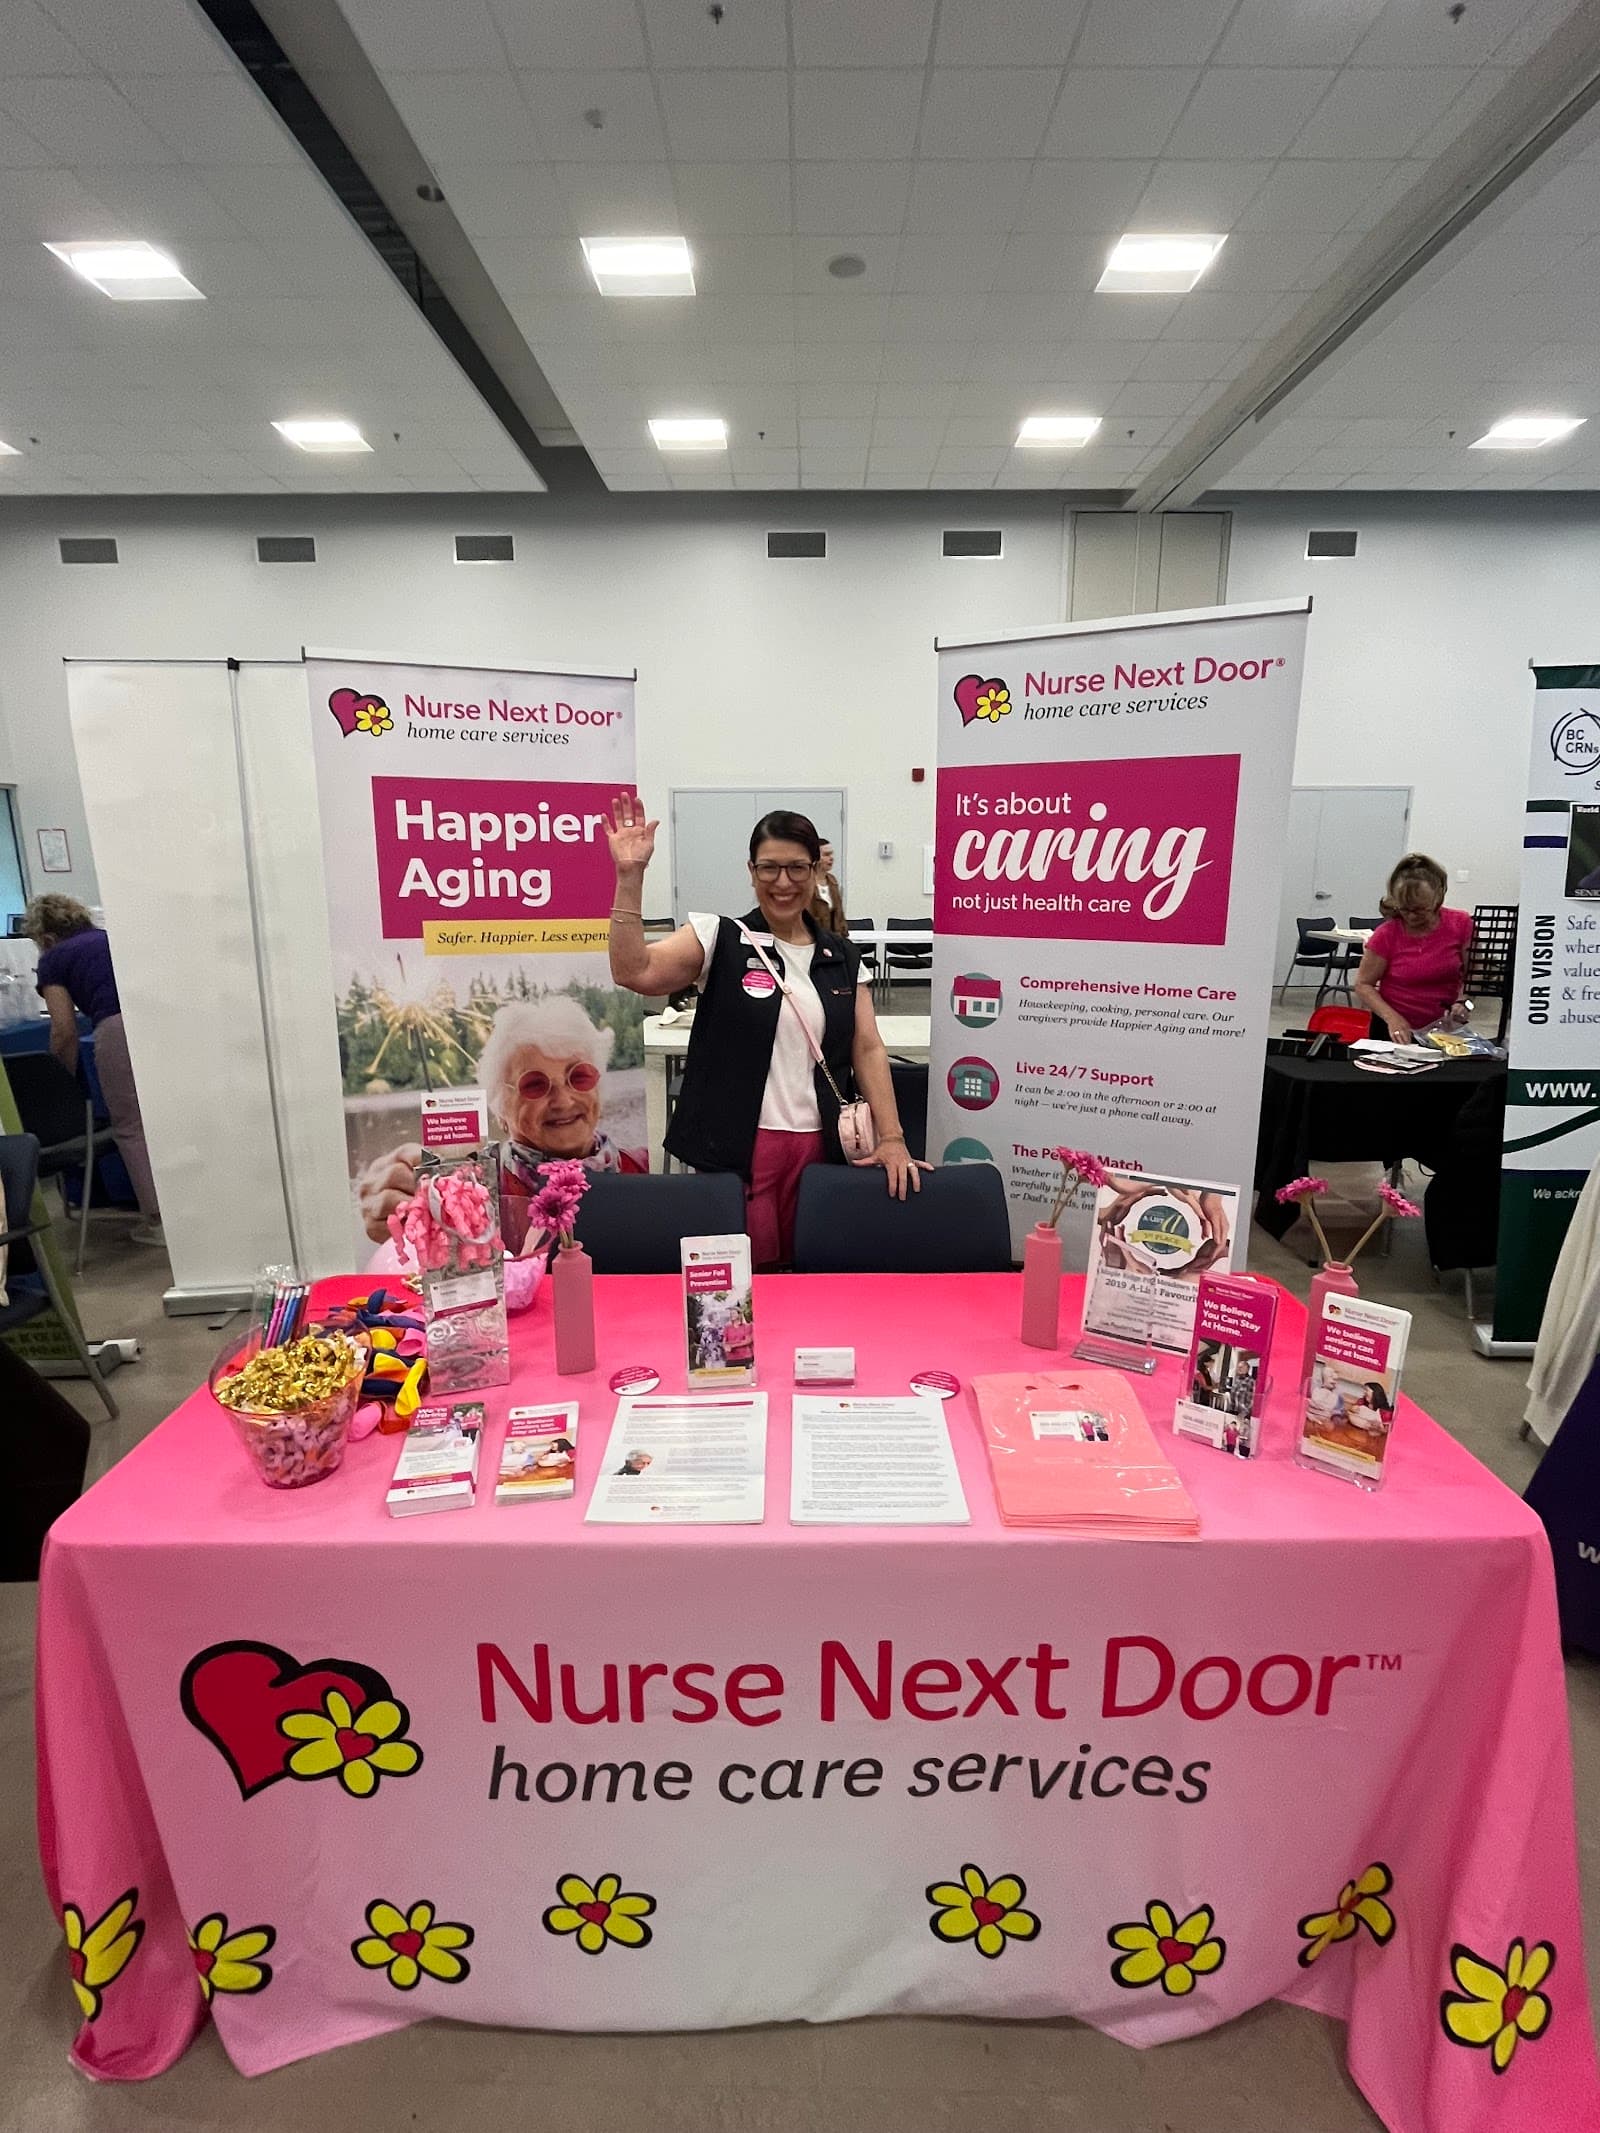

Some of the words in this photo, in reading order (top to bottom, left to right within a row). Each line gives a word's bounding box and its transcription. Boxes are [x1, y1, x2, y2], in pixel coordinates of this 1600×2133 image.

[1025, 671, 1105, 697] Nurse
[1114, 662, 1184, 690] Next
[404, 694, 480, 721] Nurse
[488, 699, 548, 724] Next
[1024, 699, 1074, 721] home
[1079, 700, 1121, 717] care
[1126, 693, 1208, 713] services
[407, 722, 455, 740] home
[460, 728, 497, 742] care
[502, 729, 570, 745] services
[1566, 729, 1585, 740] BC
[955, 793, 988, 816] It's
[994, 792, 1071, 815] about
[395, 799, 601, 851] Happier
[952, 802, 1214, 921] caring
[398, 857, 551, 907] Aging
[952, 895, 980, 910] not
[983, 893, 1018, 913] just
[1022, 894, 1083, 912] health
[1088, 899, 1131, 913] care
[1566, 915, 1597, 930] Safe
[437, 931, 477, 947] Safer.
[481, 931, 537, 945] Happier.
[541, 931, 568, 942] Less
[1531, 915, 1555, 979] VISION
[1020, 976, 1140, 994] Comprehensive
[1144, 983, 1193, 998] Home
[1197, 986, 1237, 1001] Care
[1562, 986, 1576, 1001] &
[1018, 999, 1088, 1013] Housekeeping,
[1090, 1003, 1132, 1017] cooking,
[1134, 1008, 1181, 1019] personal
[1182, 1011, 1209, 1021] care.
[1212, 1012, 1235, 1022] Our
[1528, 986, 1551, 1025] OUR
[1018, 1014, 1068, 1025] caregivers
[1069, 1017, 1108, 1028] provide
[1110, 1019, 1153, 1032] Happier
[1154, 1023, 1186, 1036] Aging
[1188, 1026, 1210, 1036] and
[1212, 1027, 1246, 1038] more!
[1016, 1061, 1046, 1075] Live
[1049, 1064, 1088, 1079] 24/7
[1090, 1068, 1154, 1087] Support
[1015, 1083, 1024, 1093] It
[1024, 1086, 1042, 1095] can
[1043, 1085, 1056, 1097] be
[1056, 1089, 1081, 1098] 2:00
[1082, 1090, 1092, 1100] in
[1094, 1091, 1110, 1102] the
[1111, 1094, 1161, 1108] afternoon
[1177, 1103, 1203, 1113] 2:00
[1205, 1105, 1217, 1114] at
[1525, 1082, 1597, 1098] www.
[1014, 1098, 1040, 1108] night
[1079, 1103, 1098, 1114] just
[1099, 1107, 1106, 1115] a
[1108, 1107, 1139, 1118] phone
[1140, 1111, 1160, 1121] call
[1161, 1114, 1194, 1127] away.
[1012, 1144, 1038, 1158] The
[1097, 1155, 1143, 1171] Match
[1011, 1165, 1052, 1178] Whether
[1010, 1179, 1052, 1193] carefully
[1022, 1192, 1048, 1203] Dad's
[1533, 1188, 1552, 1199] We
[1105, 1279, 1128, 1289] 2019
[1203, 1299, 1219, 1310] We
[1220, 1304, 1254, 1319] Believe
[1201, 1320, 1212, 1329] At
[1212, 1321, 1243, 1337] Home.
[1203, 1309, 1220, 1321] You
[1220, 1314, 1239, 1326] Can
[1240, 1319, 1261, 1333] Stay
[1325, 1335, 1357, 1349] seniors
[1357, 1344, 1374, 1354] can
[1326, 1325, 1341, 1335] We
[1342, 1329, 1375, 1345] believe
[1323, 1344, 1342, 1355] stay
[1342, 1349, 1352, 1358] at
[1353, 1351, 1382, 1367] home.
[476, 1642, 784, 1727] Nurse
[820, 1639, 1070, 1722] Next
[488, 1745, 693, 1803] home
[718, 1757, 884, 1804] care
[907, 1743, 1212, 1804] services
